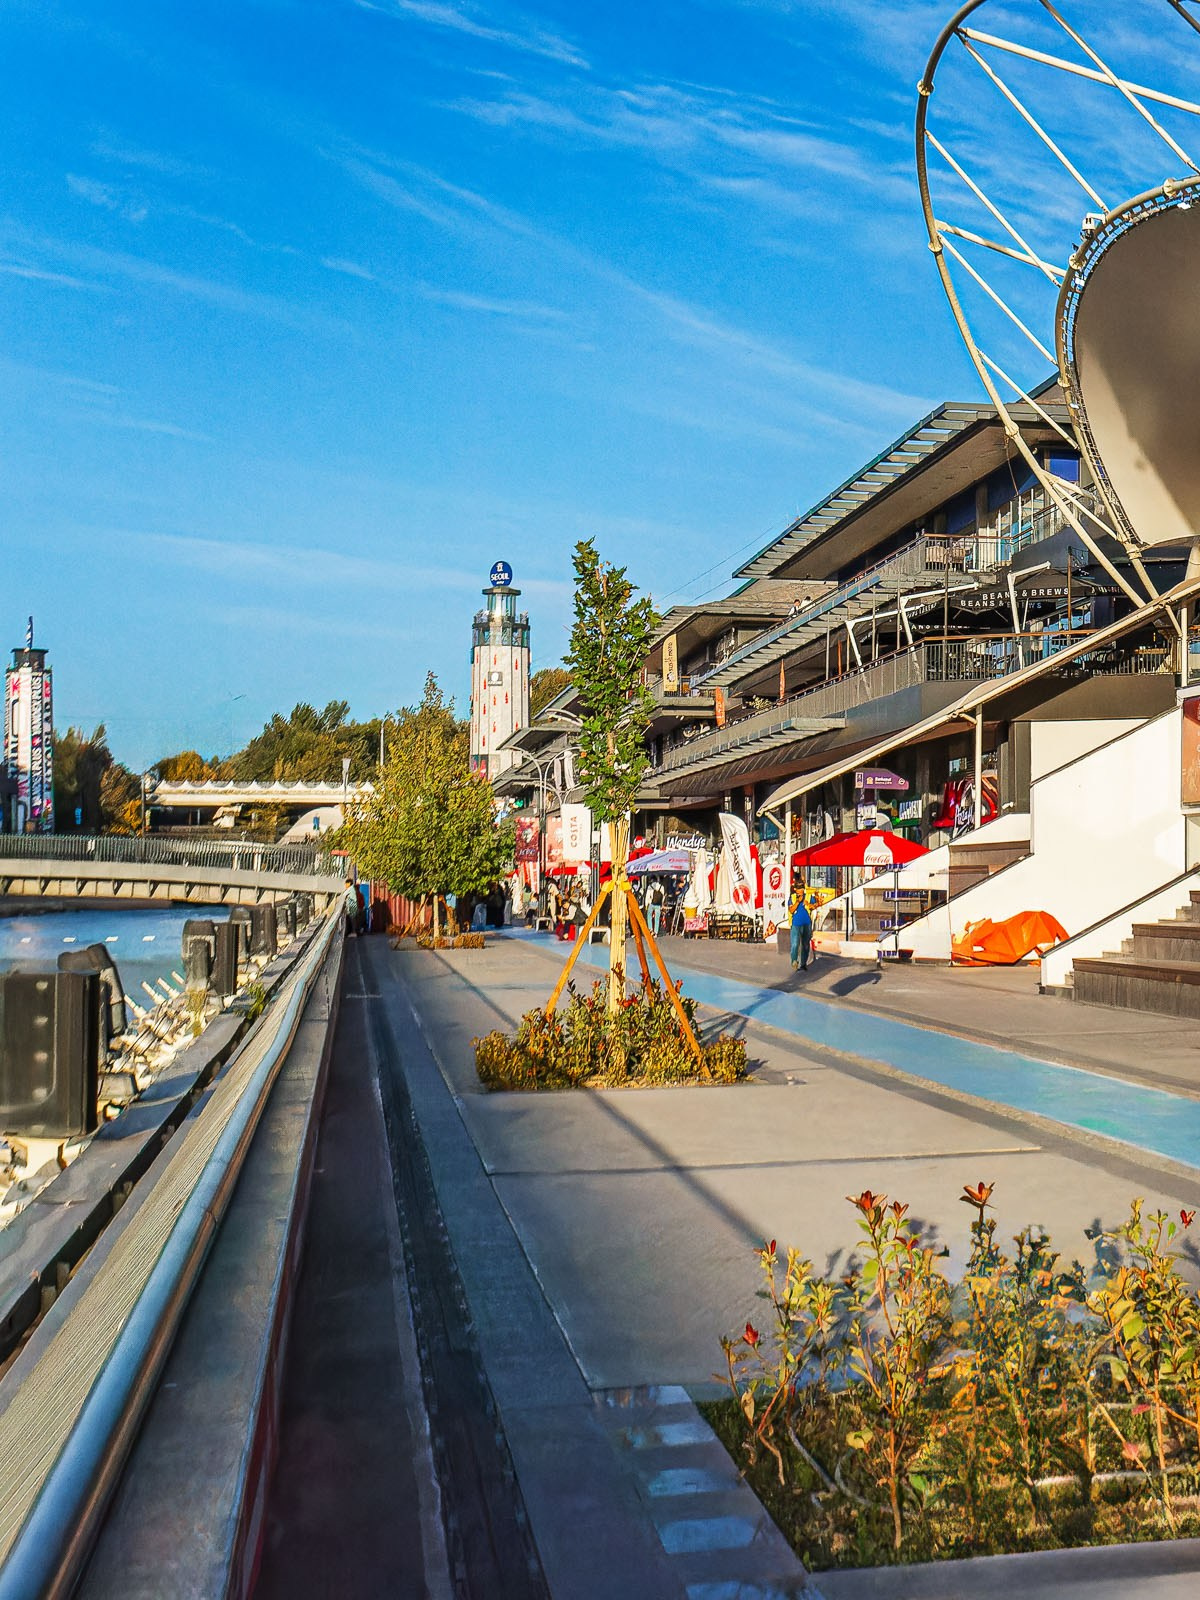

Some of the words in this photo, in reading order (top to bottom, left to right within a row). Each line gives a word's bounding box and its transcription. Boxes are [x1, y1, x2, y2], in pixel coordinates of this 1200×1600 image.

[490, 572, 510, 581] SEOUL
[982, 590, 1018, 601] BEANS
[1031, 587, 1070, 598] BREWS
[960, 599, 995, 608] BEANS
[570, 816, 578, 848] COSTA
[667, 833, 706, 850] Wendy's
